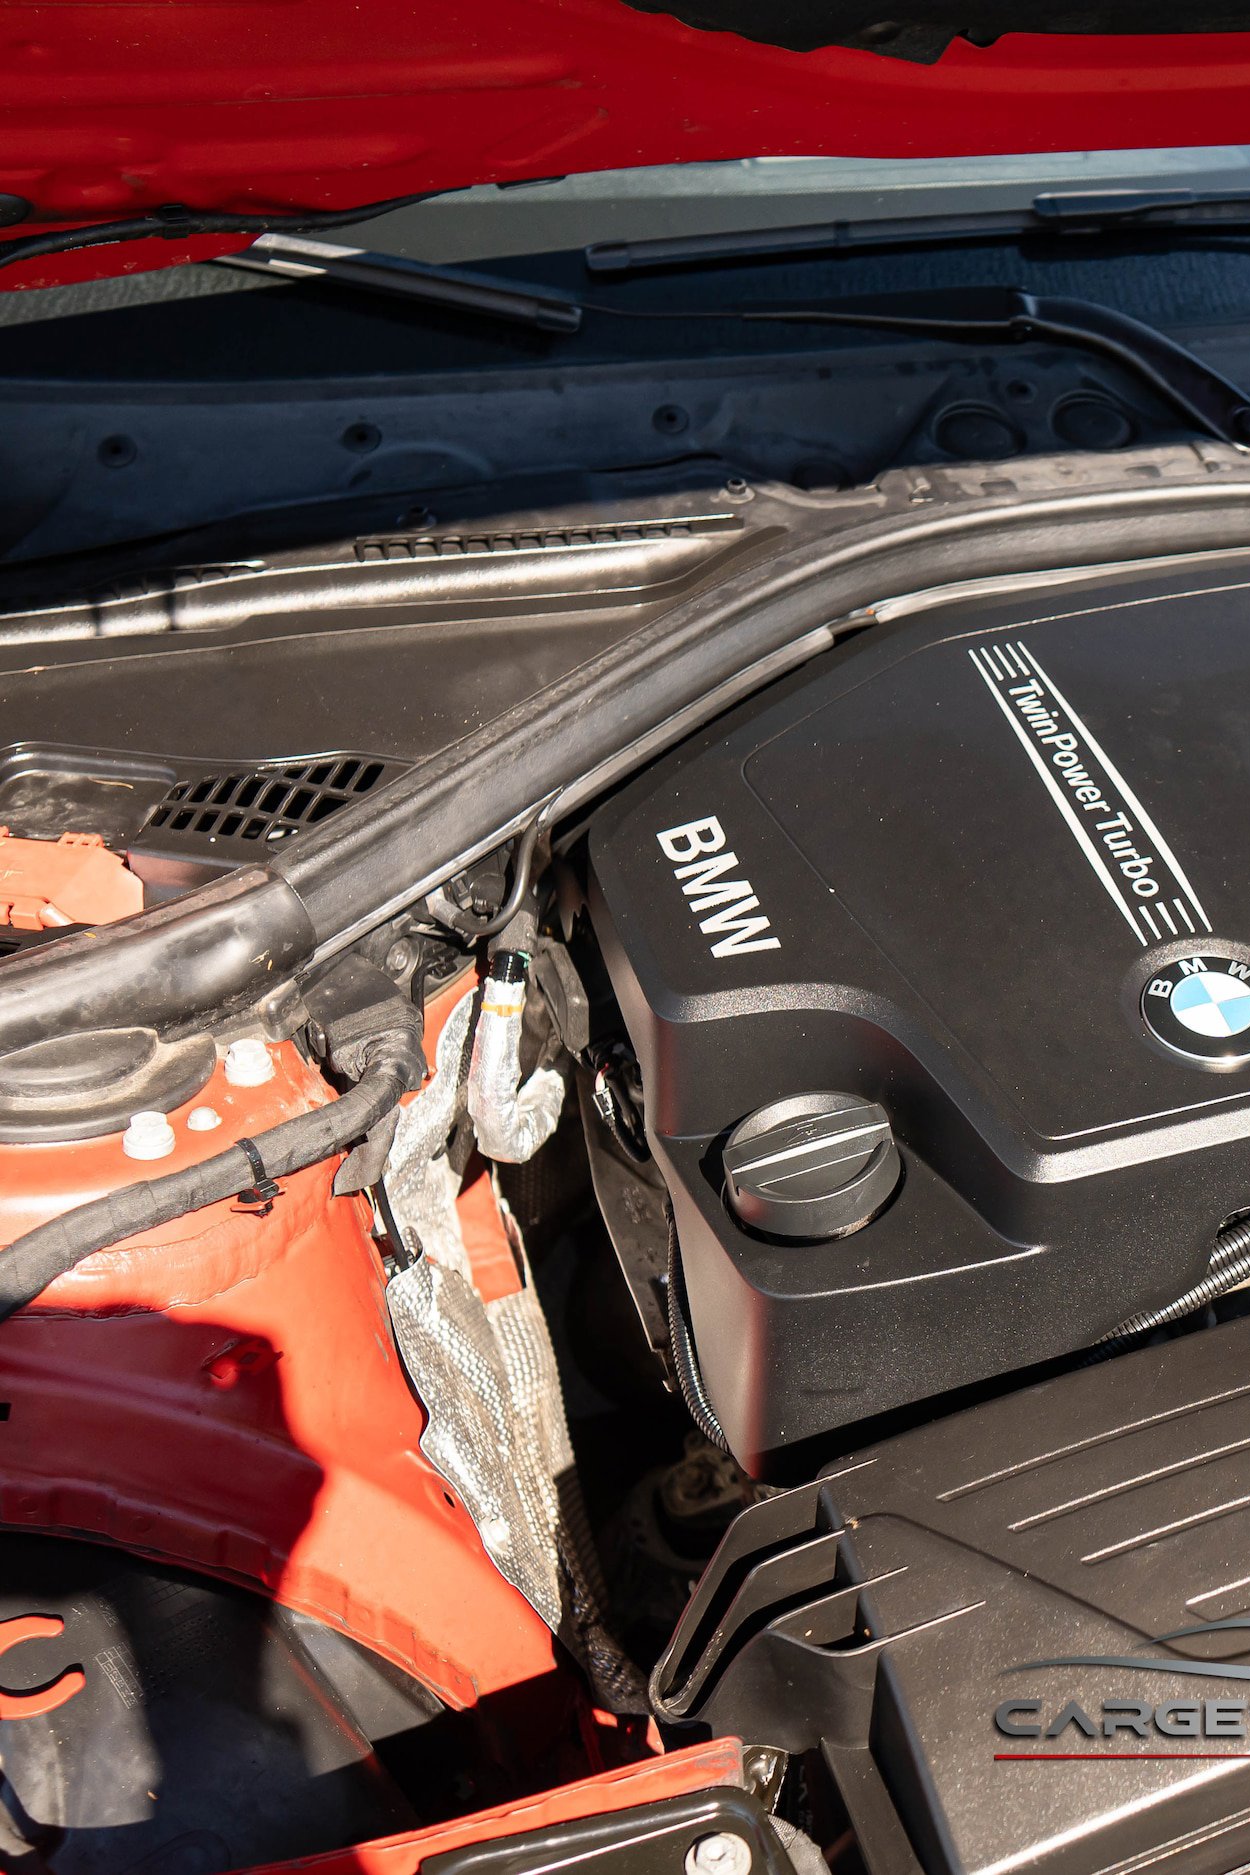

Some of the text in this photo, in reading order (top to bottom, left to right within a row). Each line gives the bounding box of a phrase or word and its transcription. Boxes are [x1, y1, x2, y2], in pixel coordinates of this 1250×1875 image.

[1008, 678, 1160, 898] TwinPower Turbo
[656, 815, 782, 959] BMW
